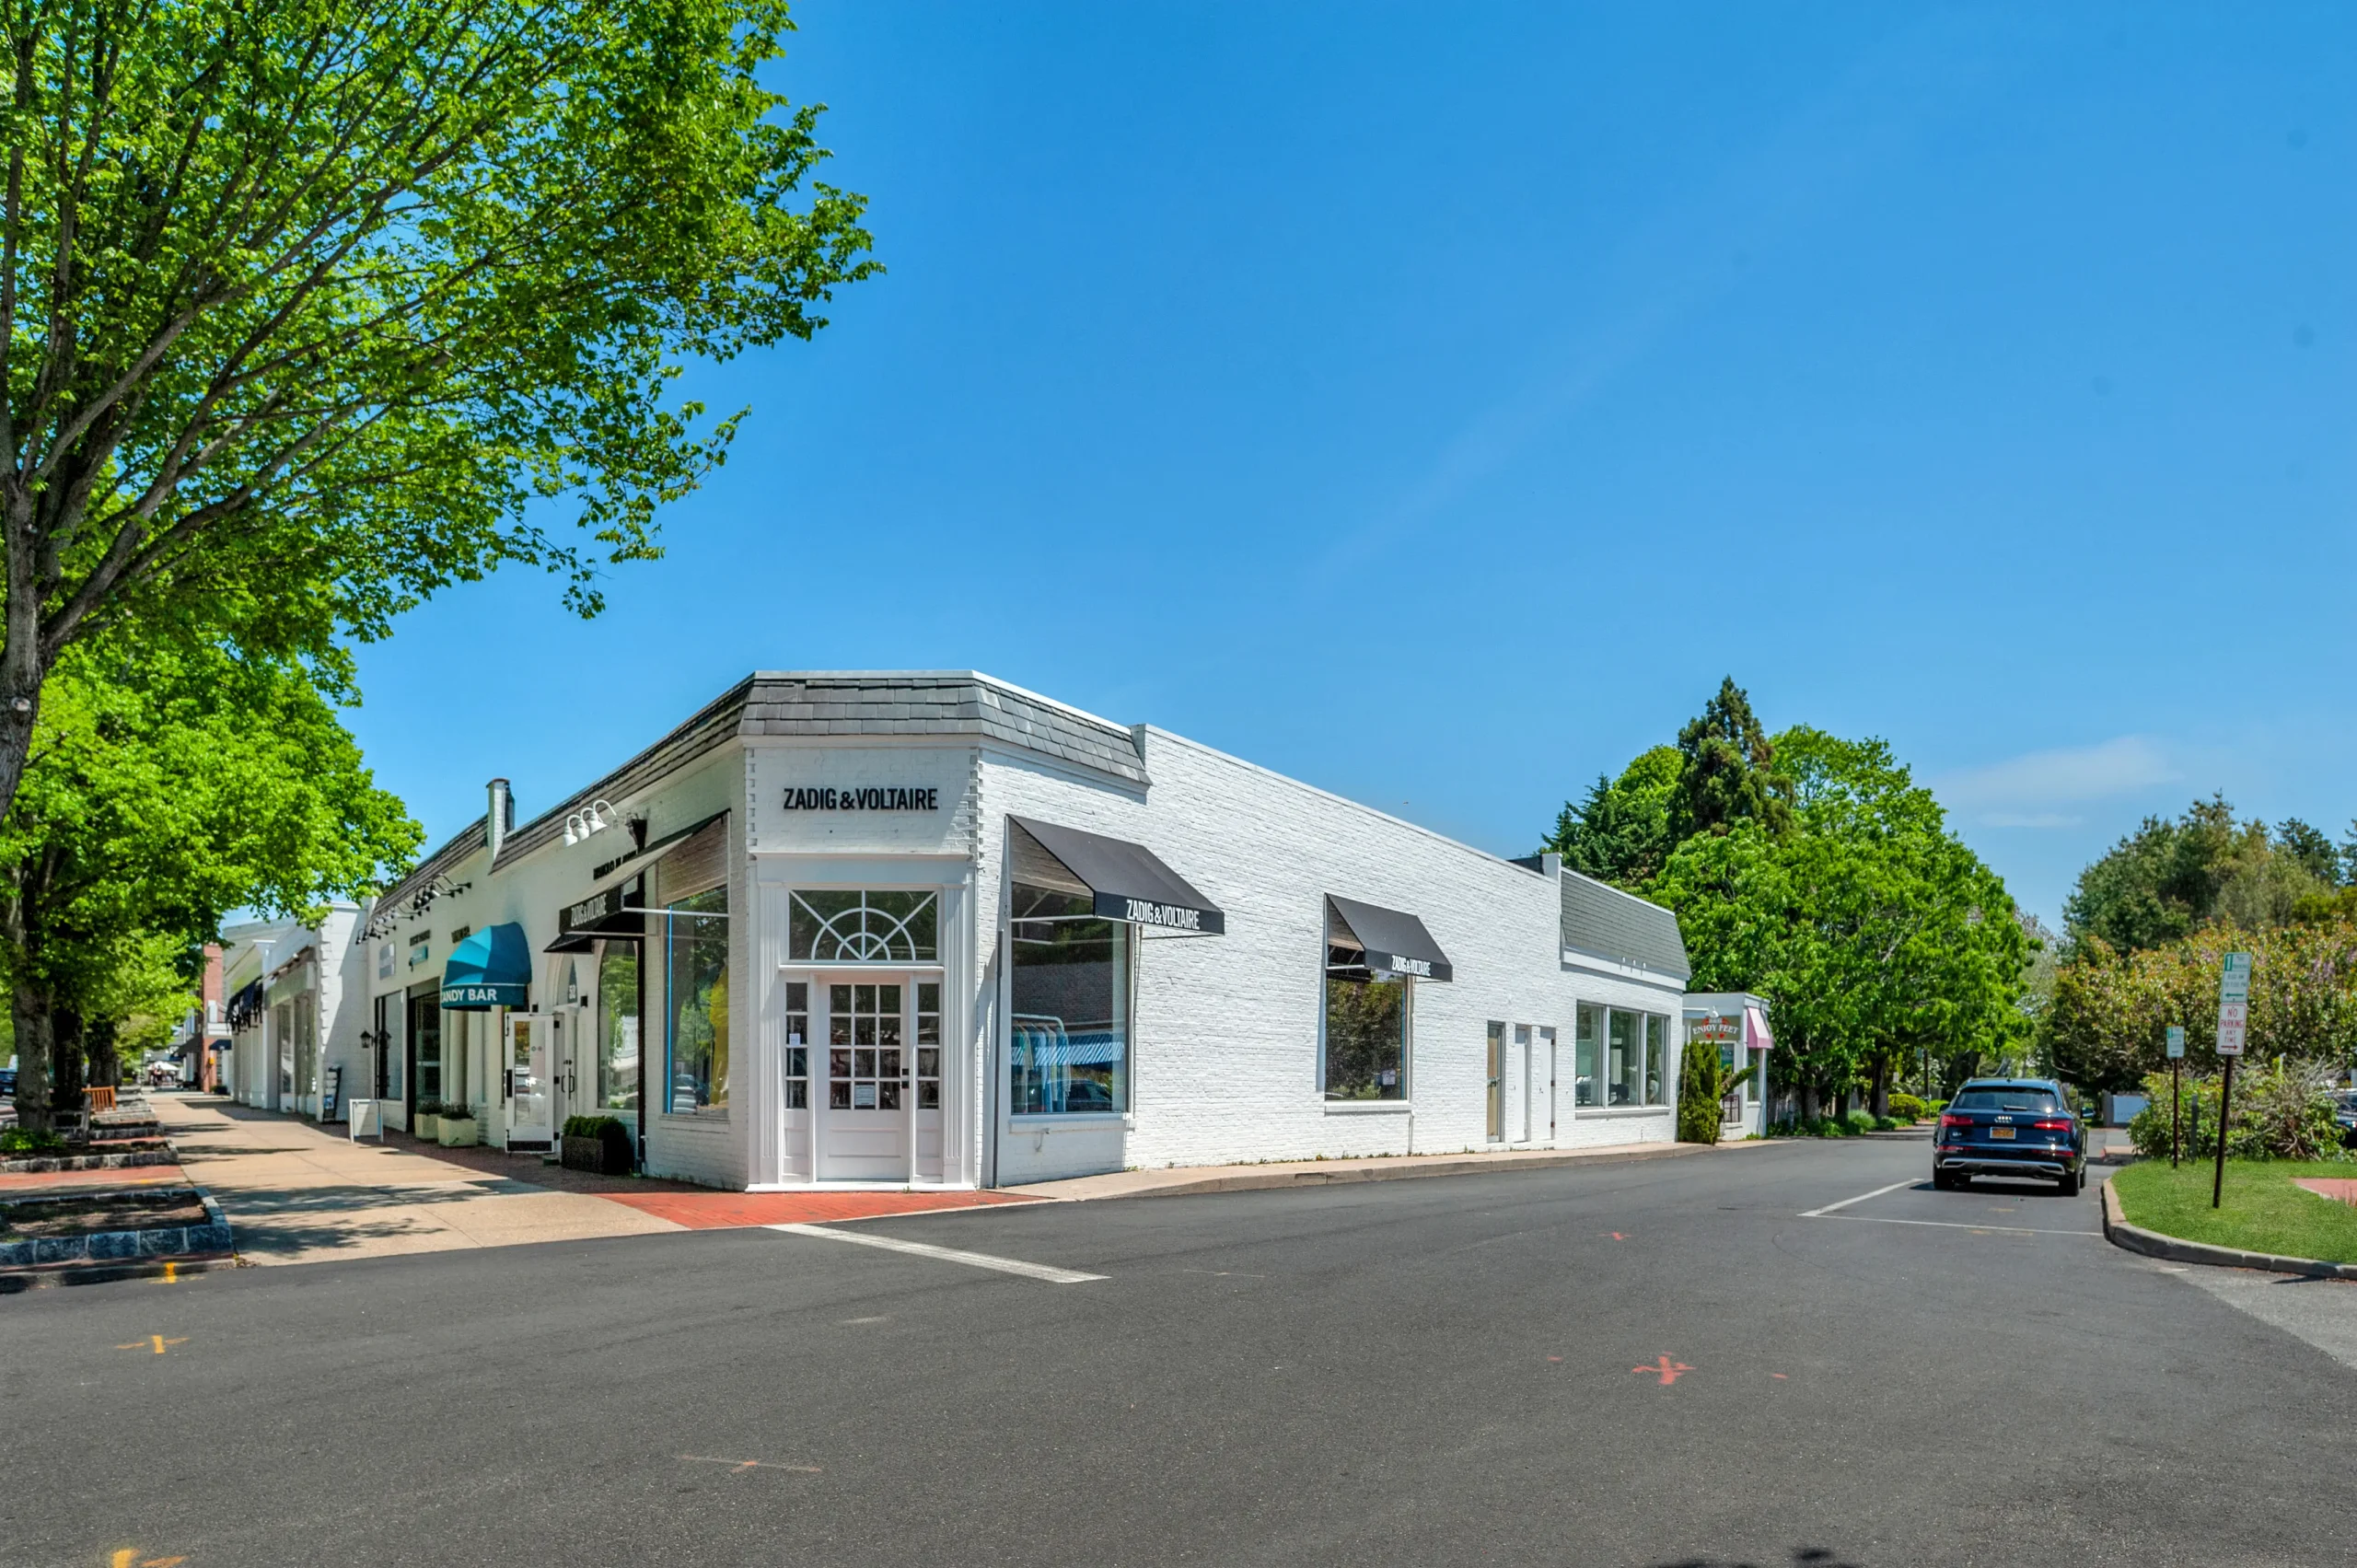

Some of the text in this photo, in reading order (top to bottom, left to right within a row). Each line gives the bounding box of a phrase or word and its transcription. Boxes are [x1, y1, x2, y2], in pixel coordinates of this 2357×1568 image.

[441, 988, 497, 1003] ANDY BAR
[2227, 1008, 2237, 1018] NO
[2220, 1019, 2244, 1028] PARKING
[1692, 1024, 1739, 1035] ENJOY FEET
